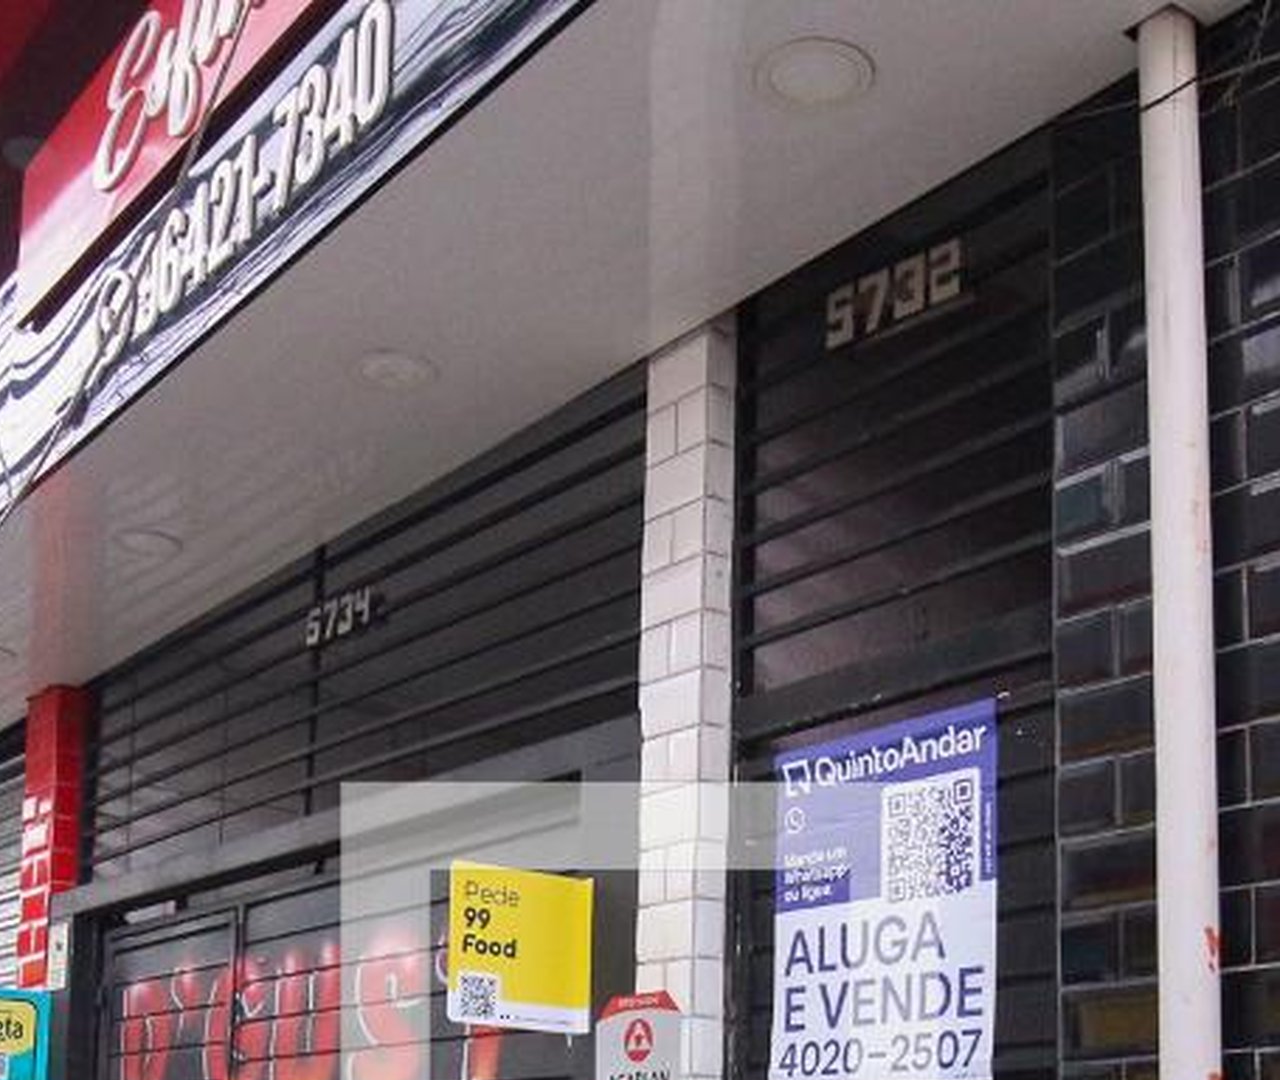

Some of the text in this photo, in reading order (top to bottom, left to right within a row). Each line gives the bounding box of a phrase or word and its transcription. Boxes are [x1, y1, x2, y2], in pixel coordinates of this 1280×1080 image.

[825, 237, 962, 350] 5732
[305, 585, 370, 648] 5734
[815, 724, 987, 788] QuintoAndar
[463, 907, 491, 930] 99
[464, 880, 521, 907] Pede
[462, 934, 518, 959] Food
[784, 912, 946, 977] ALUGA
[784, 966, 985, 1033] E VENDE
[778, 1029, 983, 1078] 4020-2507
